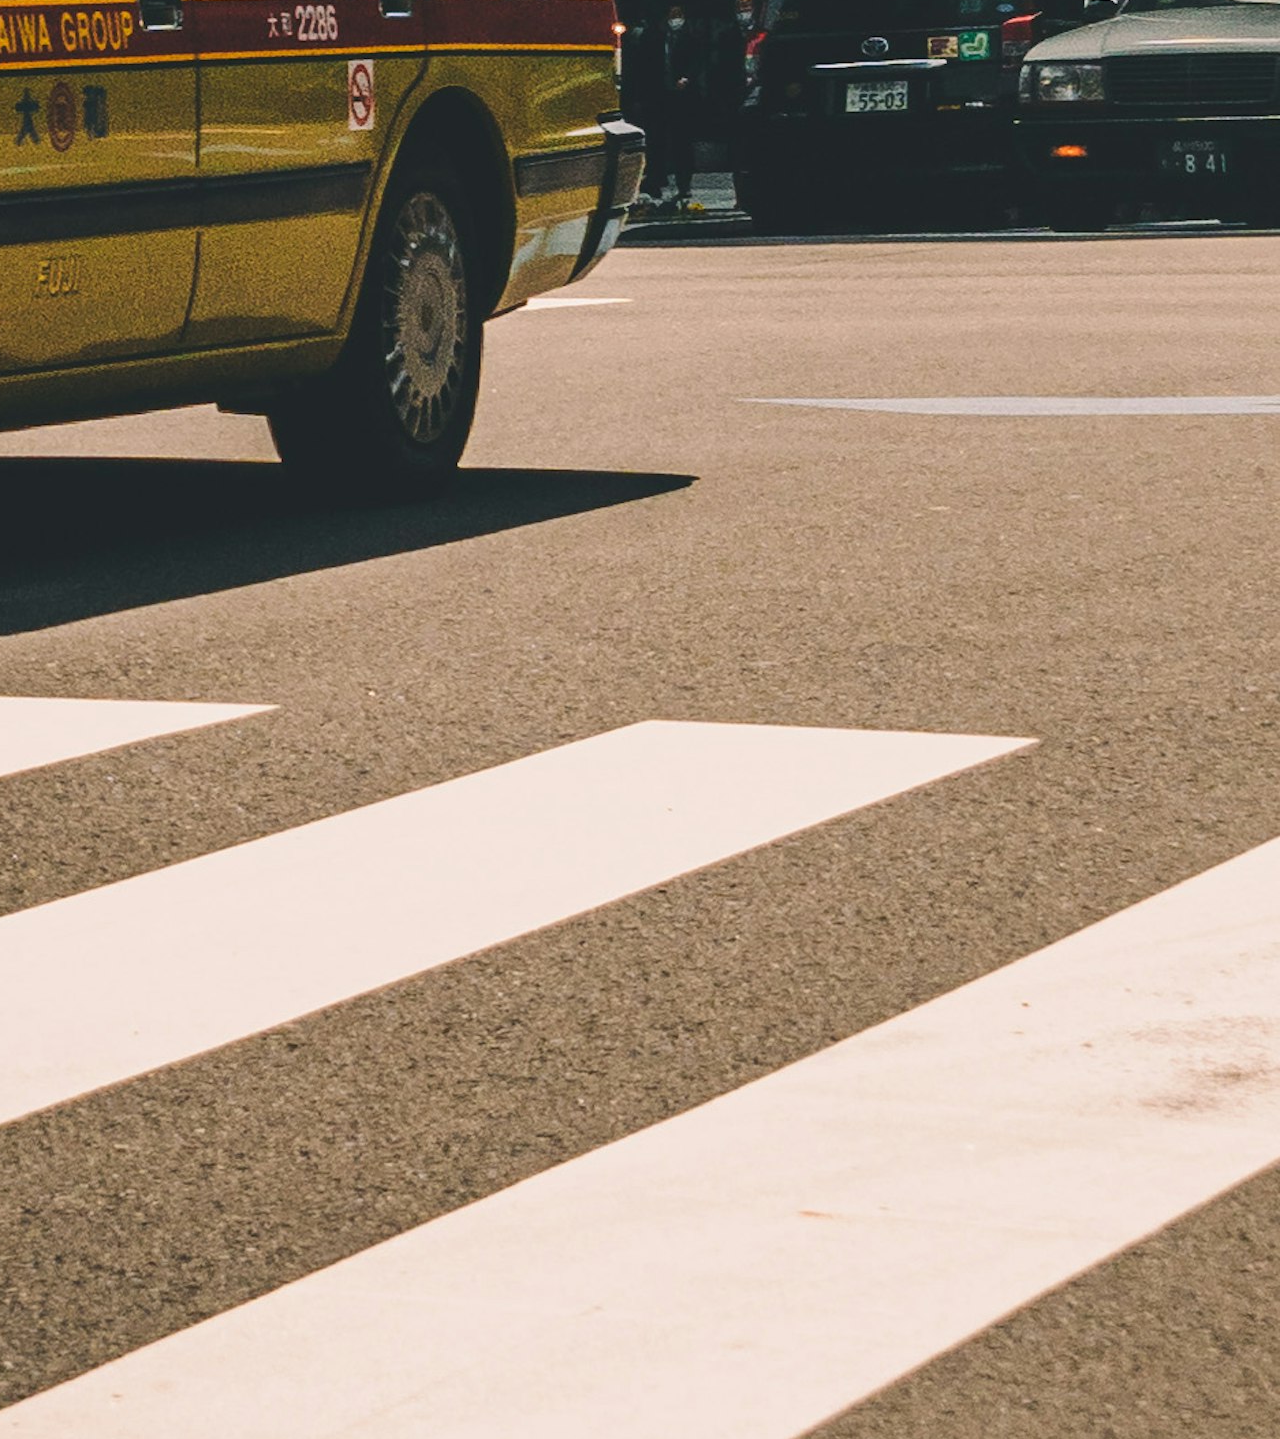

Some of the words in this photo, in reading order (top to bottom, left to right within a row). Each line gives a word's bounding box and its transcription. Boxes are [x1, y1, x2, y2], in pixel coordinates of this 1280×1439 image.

[60, 10, 134, 52] GROUP
[294, 5, 339, 41] 2286
[858, 92, 905, 110] 55-03
